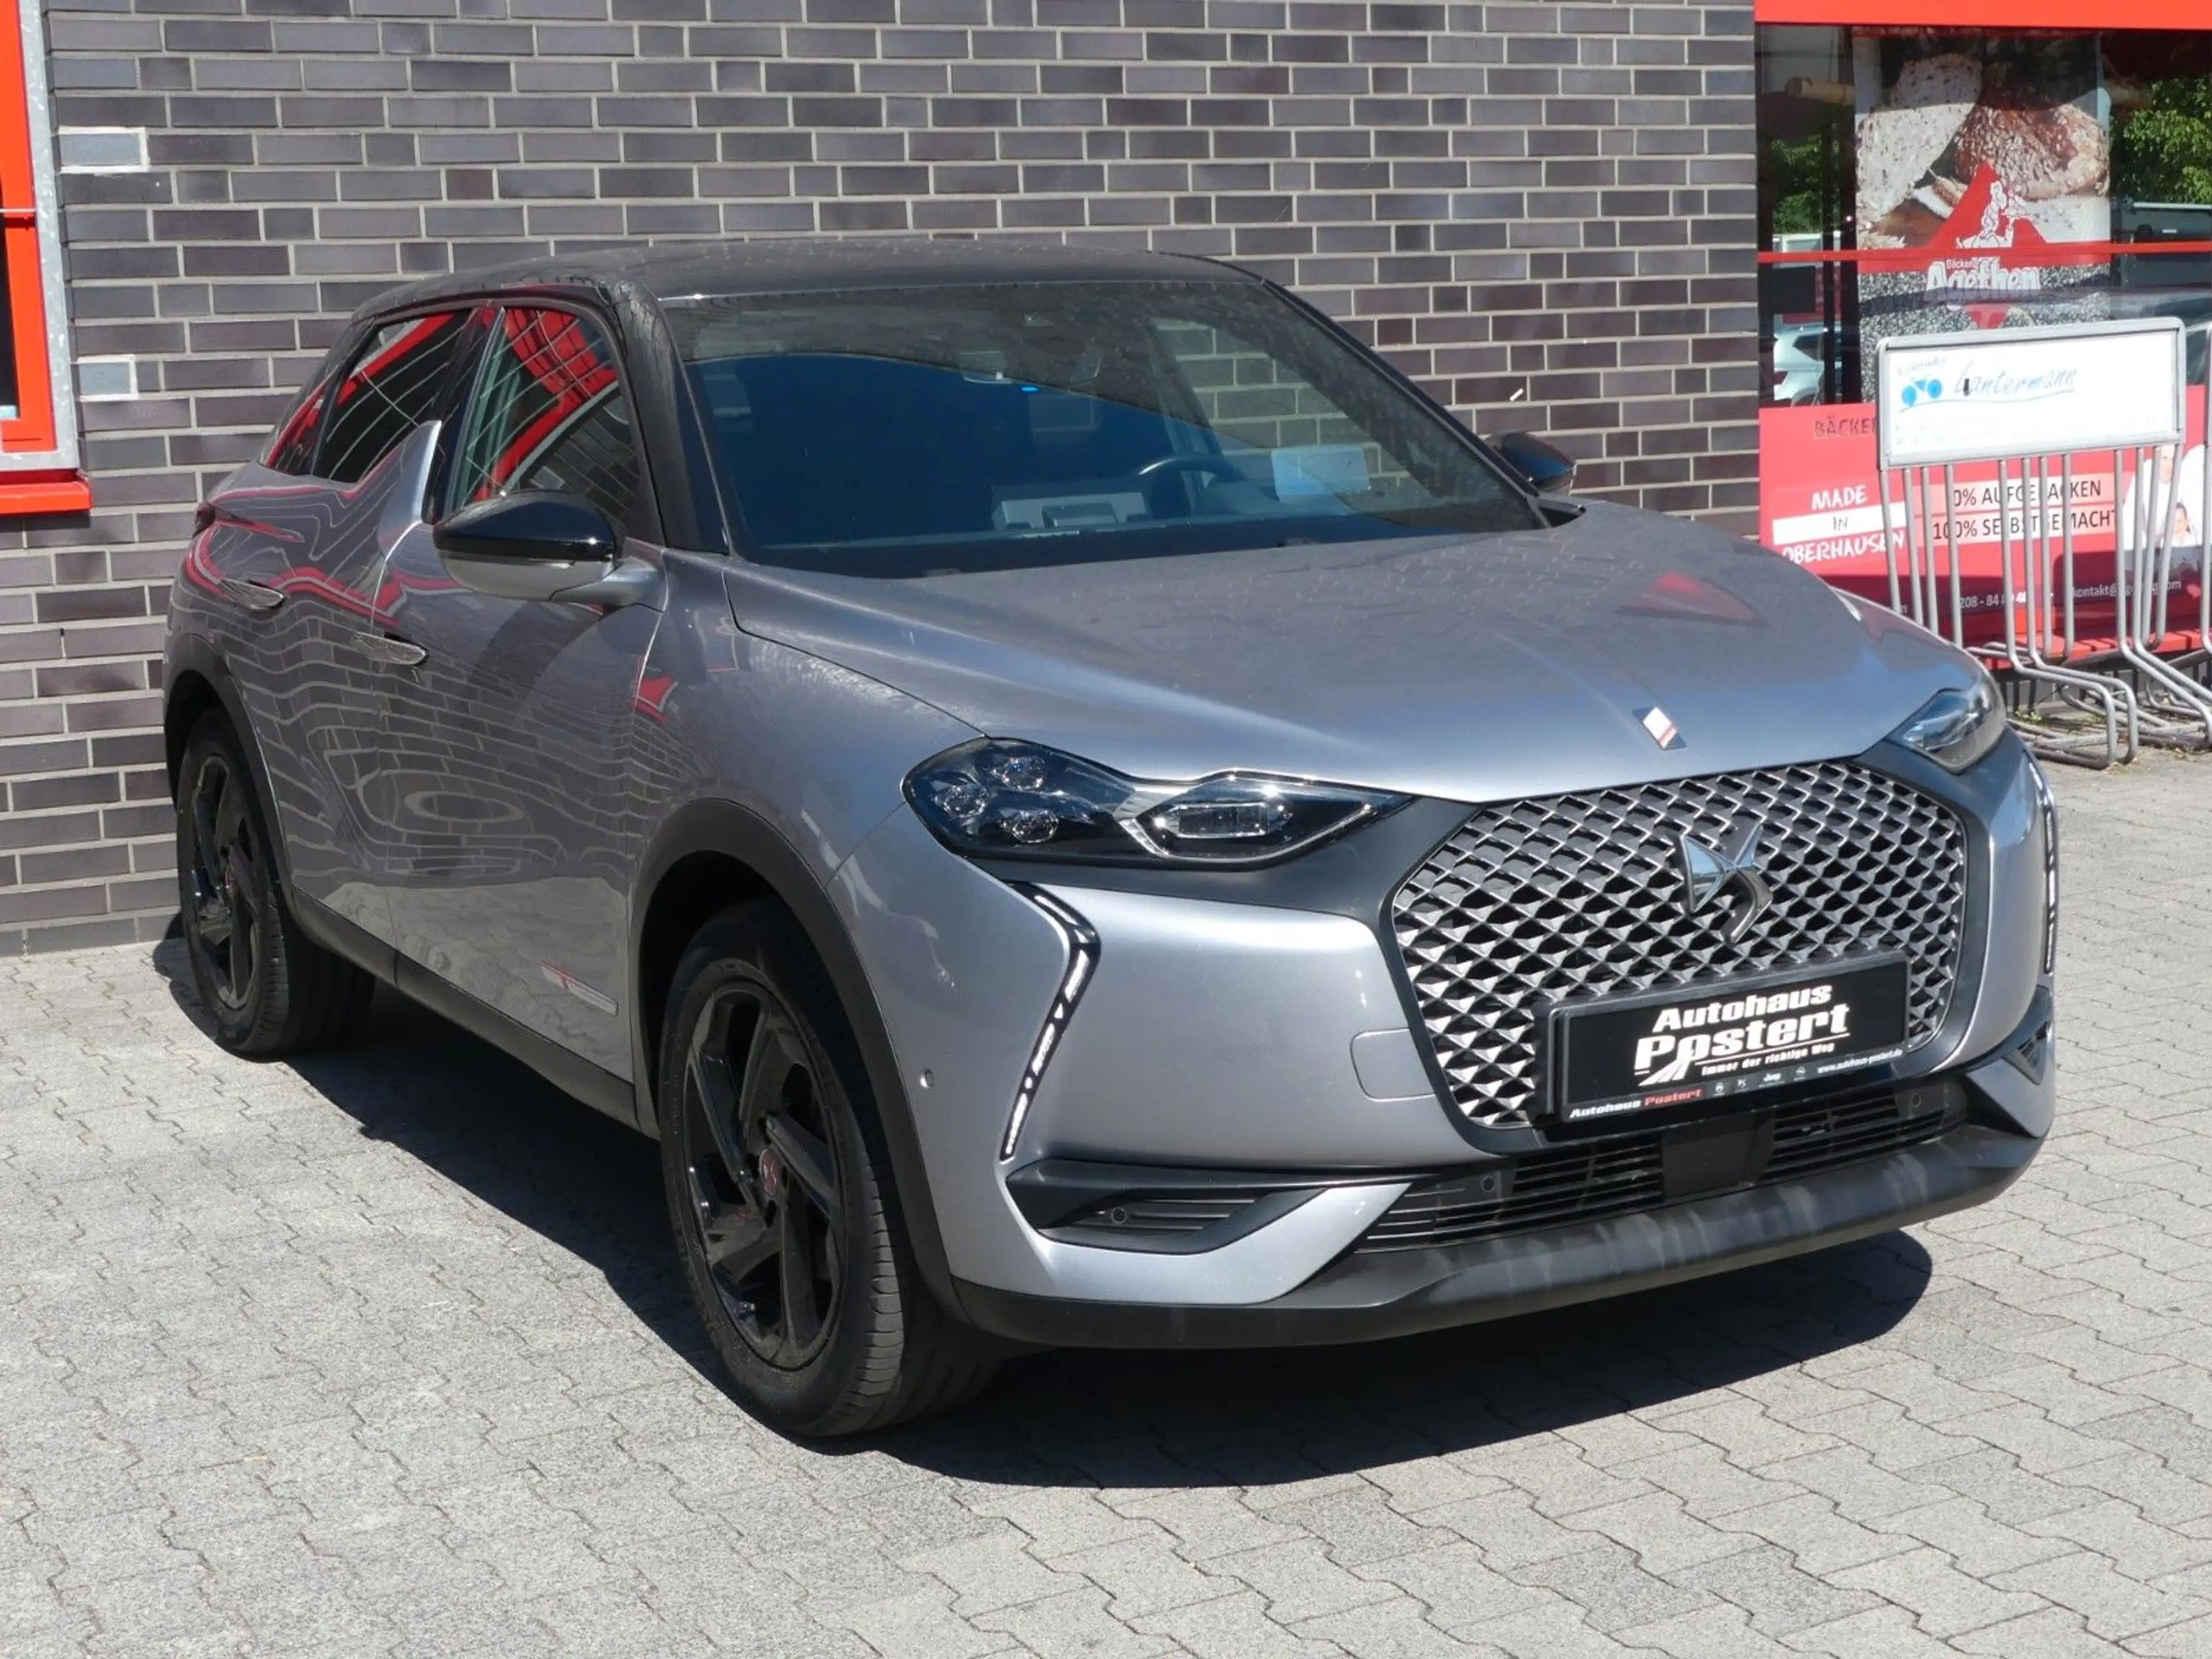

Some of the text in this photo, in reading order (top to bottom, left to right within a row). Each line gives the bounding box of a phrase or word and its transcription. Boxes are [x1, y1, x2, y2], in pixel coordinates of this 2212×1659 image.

[1812, 484, 1868, 510] MADE
[1833, 516, 1848, 531] IN
[1652, 984, 1833, 1033] Autohaus
[1634, 1003, 1850, 1078] Postert
[1742, 1058, 1763, 1069] der
[1569, 1088, 1703, 1119] Autohaus Postert
